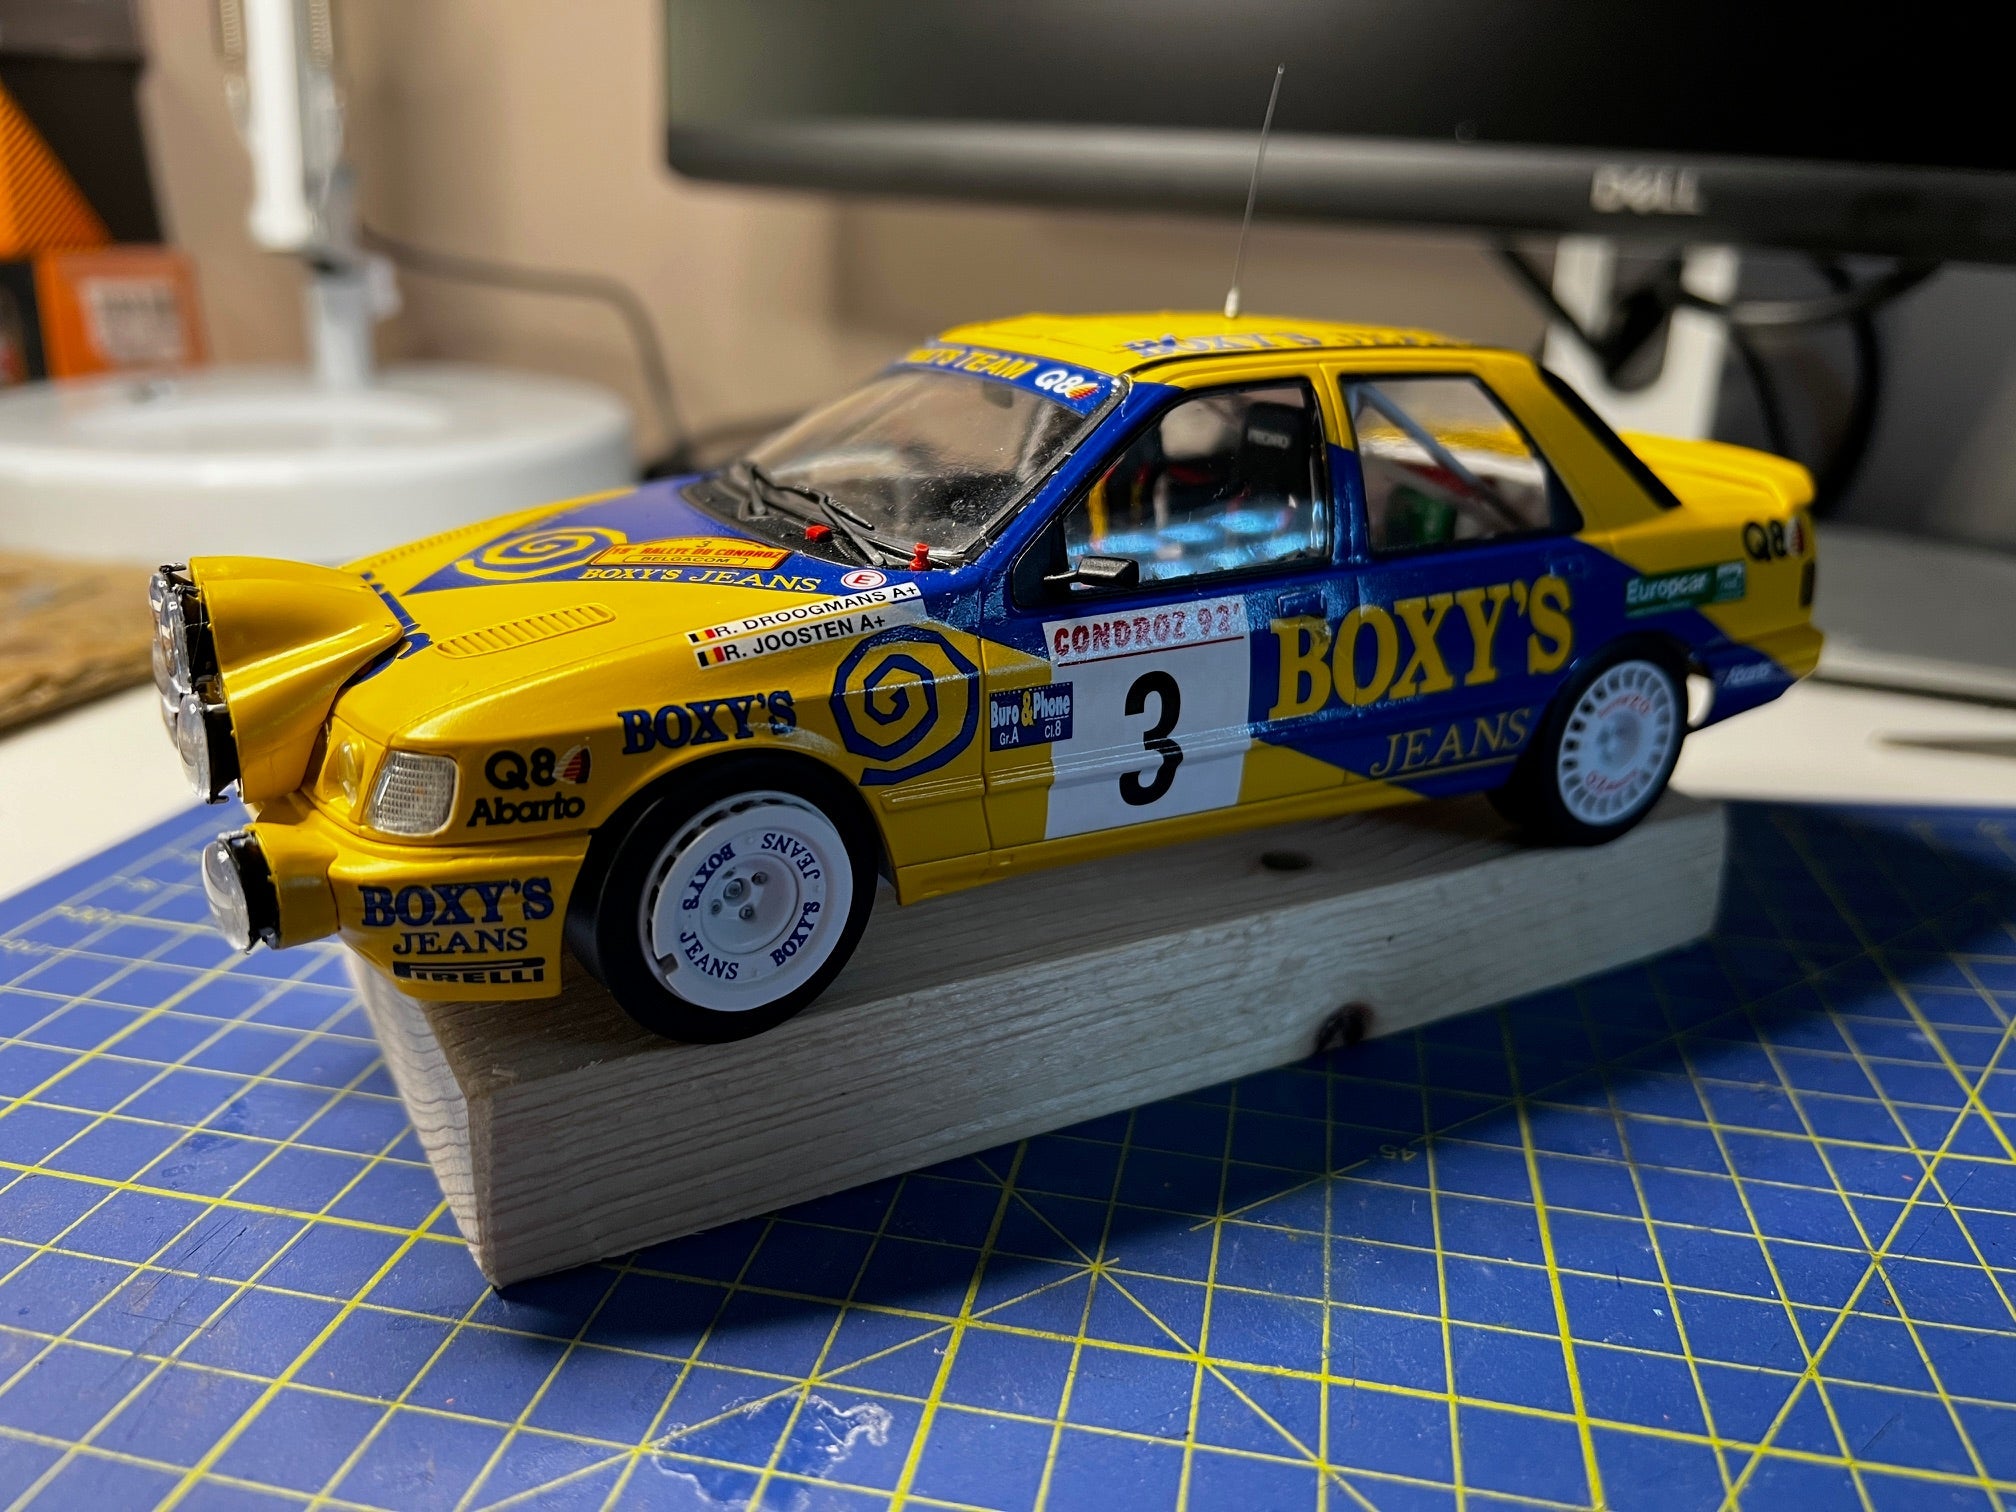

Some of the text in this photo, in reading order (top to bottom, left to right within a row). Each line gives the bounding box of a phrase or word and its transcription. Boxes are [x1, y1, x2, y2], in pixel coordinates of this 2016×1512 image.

[954, 350, 1039, 380] TEAM
[1034, 369, 1085, 396] Q8
[640, 547, 688, 556] RALLYE
[692, 548, 713, 556] DU
[715, 549, 783, 560] CONDROZ
[1742, 519, 1788, 561] Q8
[577, 568, 822, 592] BOXY'S JEANS
[852, 574, 875, 586] E
[1625, 574, 1708, 605] Europcar
[714, 586, 917, 638] R. DROOGMANS A+
[724, 613, 886, 661] R. JOOSTEN A+
[1053, 611, 1187, 657] CONDROZ
[1268, 574, 1574, 721] BOXY'S
[618, 690, 798, 755] BOXY'S
[990, 701, 1020, 729] Buro
[1033, 690, 1071, 720] Phone
[1119, 670, 1184, 806] 3
[1369, 707, 1531, 777] JEANS
[485, 747, 557, 791] Q8
[466, 792, 586, 827] Abarto
[760, 832, 821, 880] JEANS
[358, 877, 555, 927] BOXY'S
[392, 926, 528, 955] JEANS
[679, 931, 740, 980] JEANS
[392, 956, 546, 984] PIRELLI
